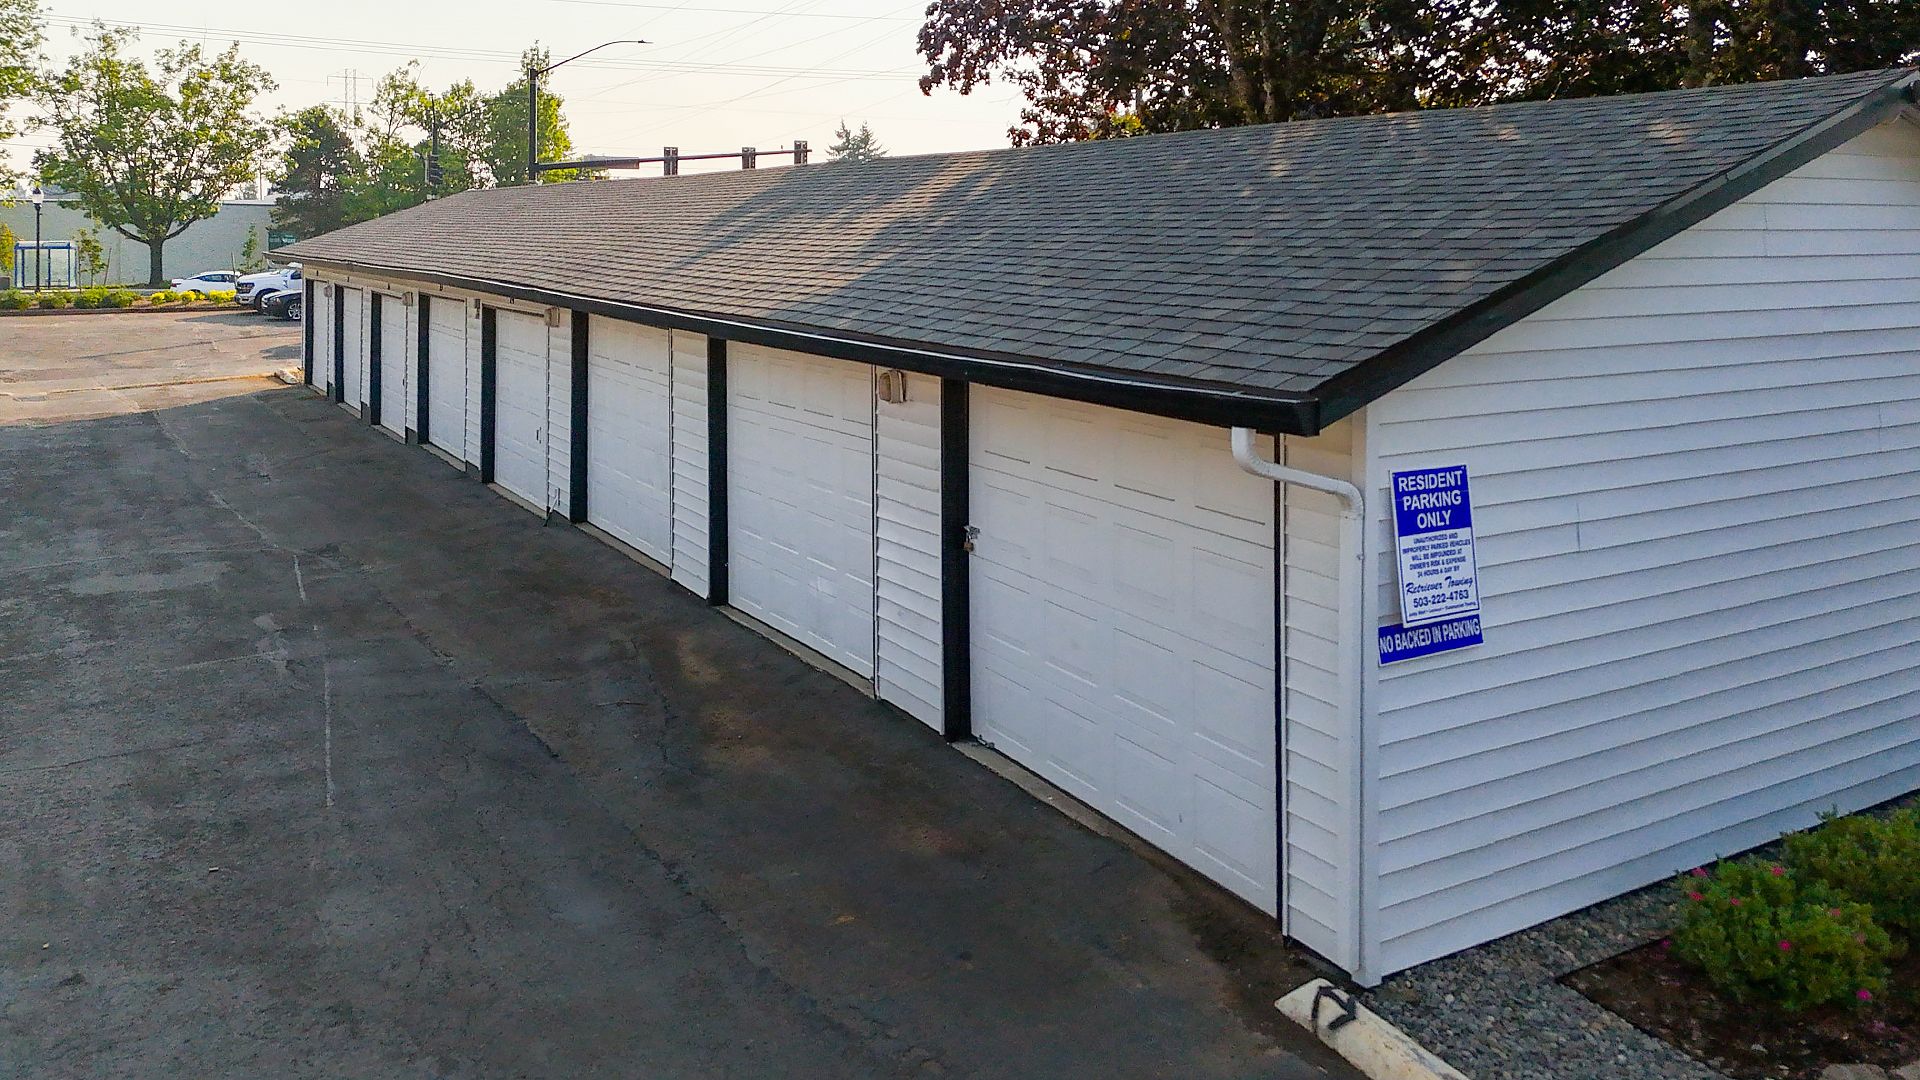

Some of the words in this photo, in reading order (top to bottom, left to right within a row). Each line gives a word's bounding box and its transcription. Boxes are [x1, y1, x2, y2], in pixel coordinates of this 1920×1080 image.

[1398, 470, 1463, 492] RESIDENT
[1403, 490, 1462, 511] PARKING
[1417, 510, 1451, 529] ONLY
[1406, 582, 1442, 595] Retriever
[1444, 576, 1473, 588] Towing
[1413, 589, 1469, 608] 503-222-4763
[1380, 635, 1394, 654] NO
[1394, 628, 1431, 651] BACKED
[1432, 625, 1442, 644] IN
[1442, 618, 1480, 641] PARKING
